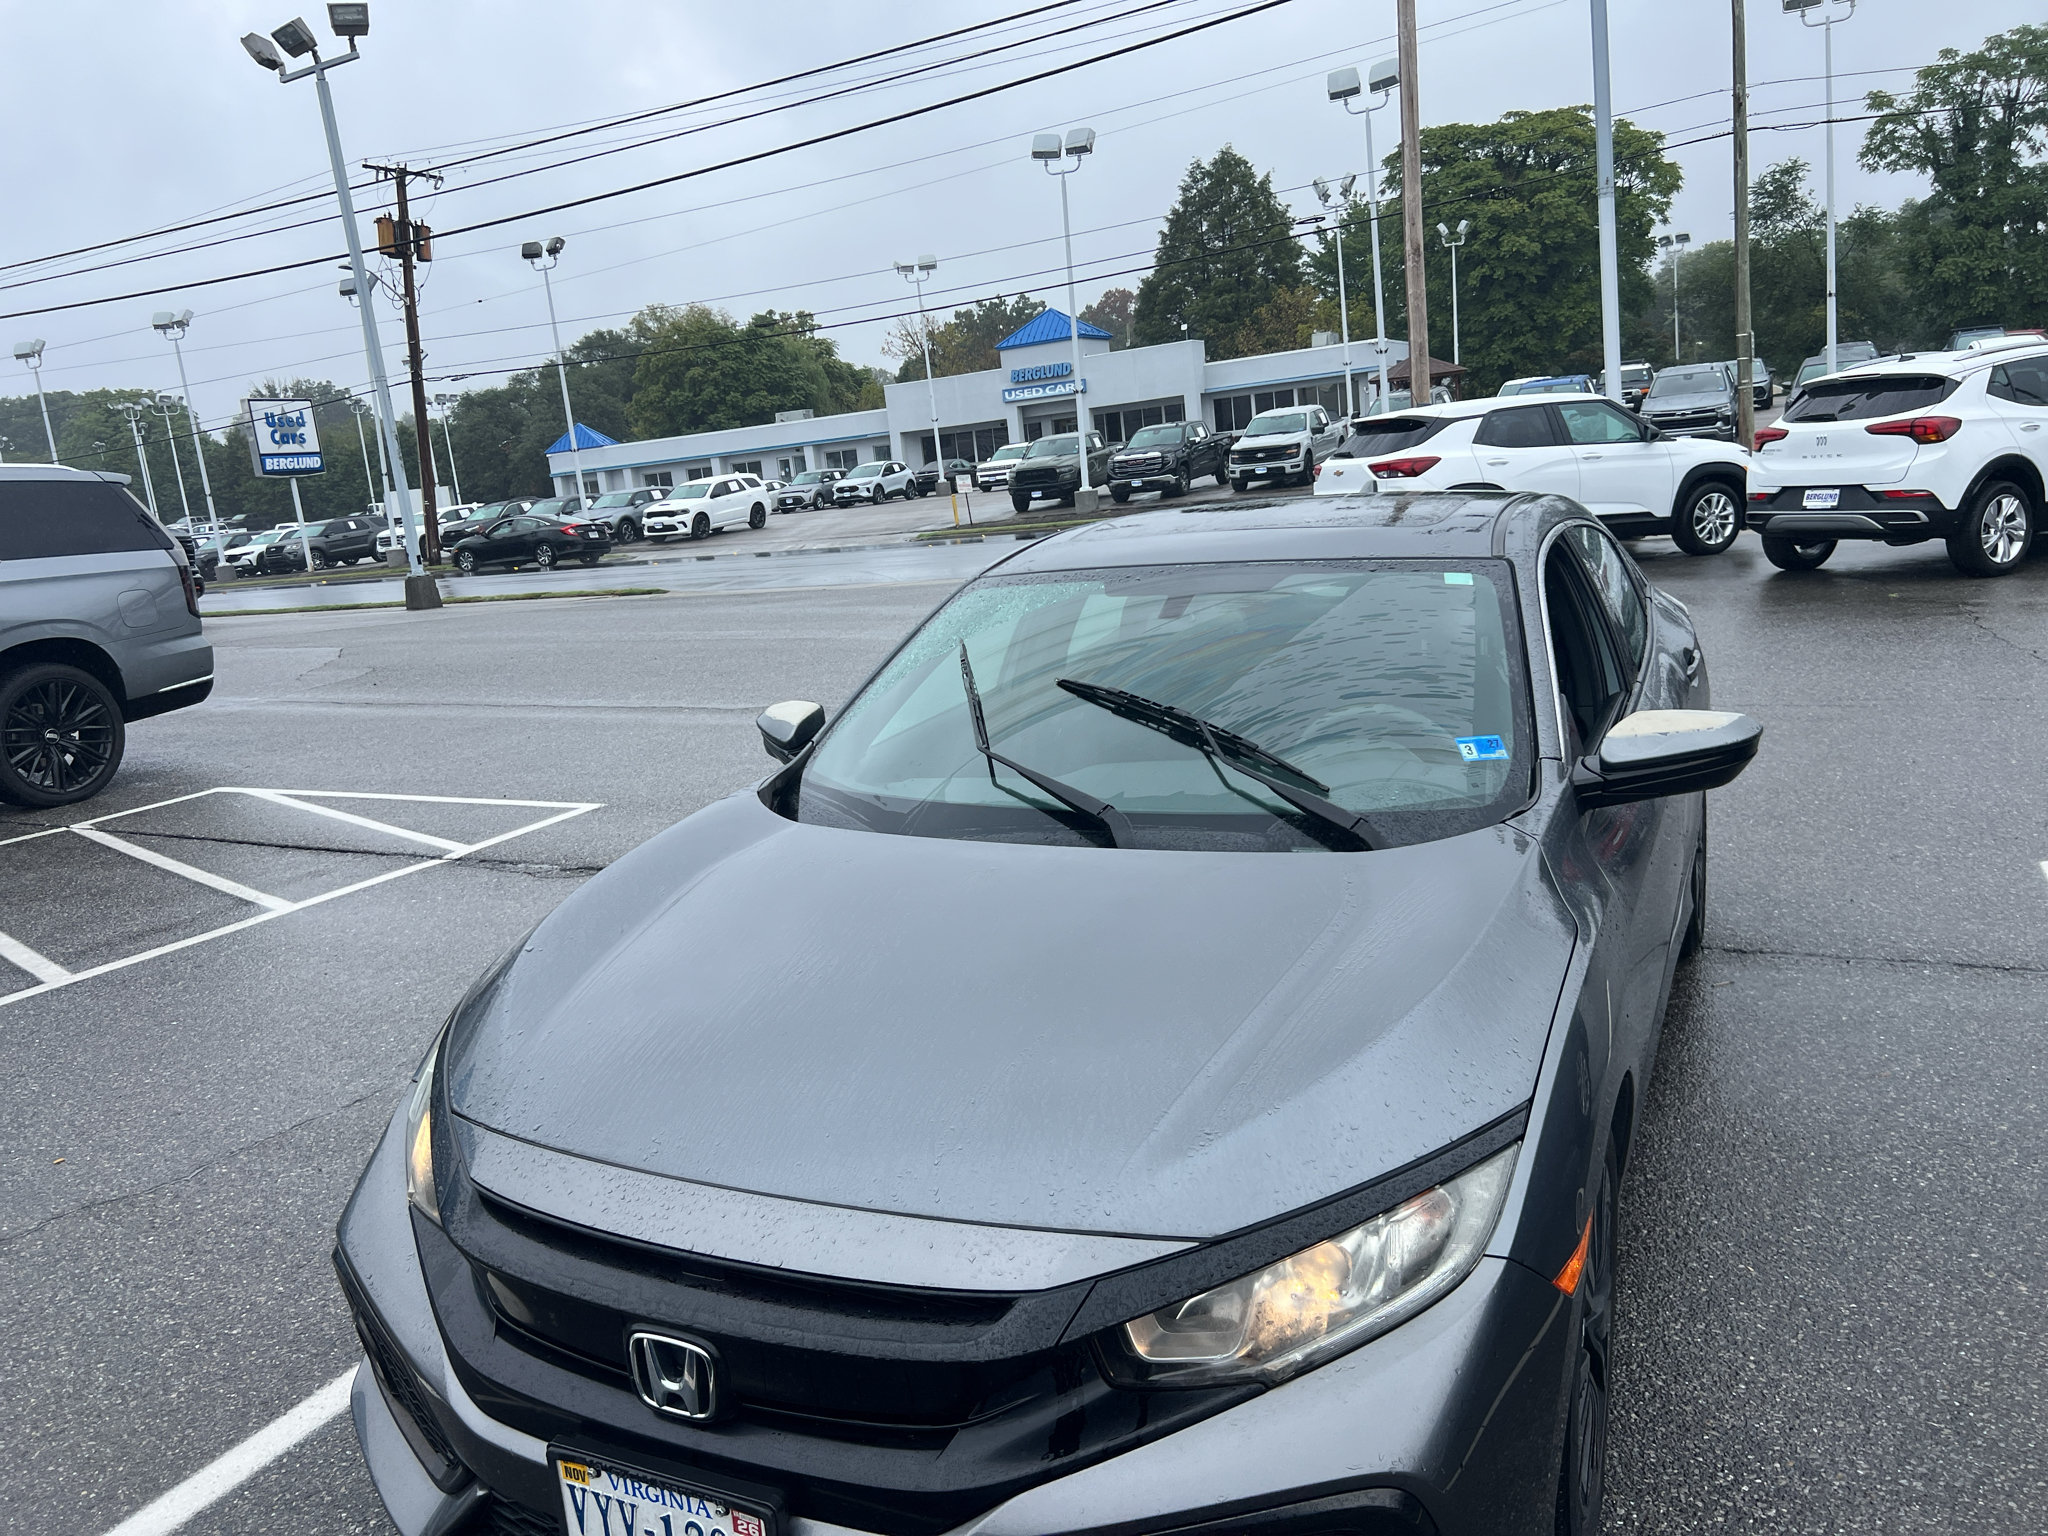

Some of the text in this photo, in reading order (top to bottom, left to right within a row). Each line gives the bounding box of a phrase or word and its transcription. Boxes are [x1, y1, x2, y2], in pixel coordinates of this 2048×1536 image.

[1011, 363, 1072, 382] BERGLUND
[1004, 387, 1043, 399] USED
[264, 410, 306, 428] Used
[270, 429, 307, 445] Cars
[265, 457, 321, 470] BERGLUND
[1464, 744, 1474, 756] 3
[1487, 739, 1499, 748] 27
[564, 1465, 586, 1482] NOV
[606, 1471, 713, 1520] VIRGINIA
[737, 1519, 759, 1536] 26
